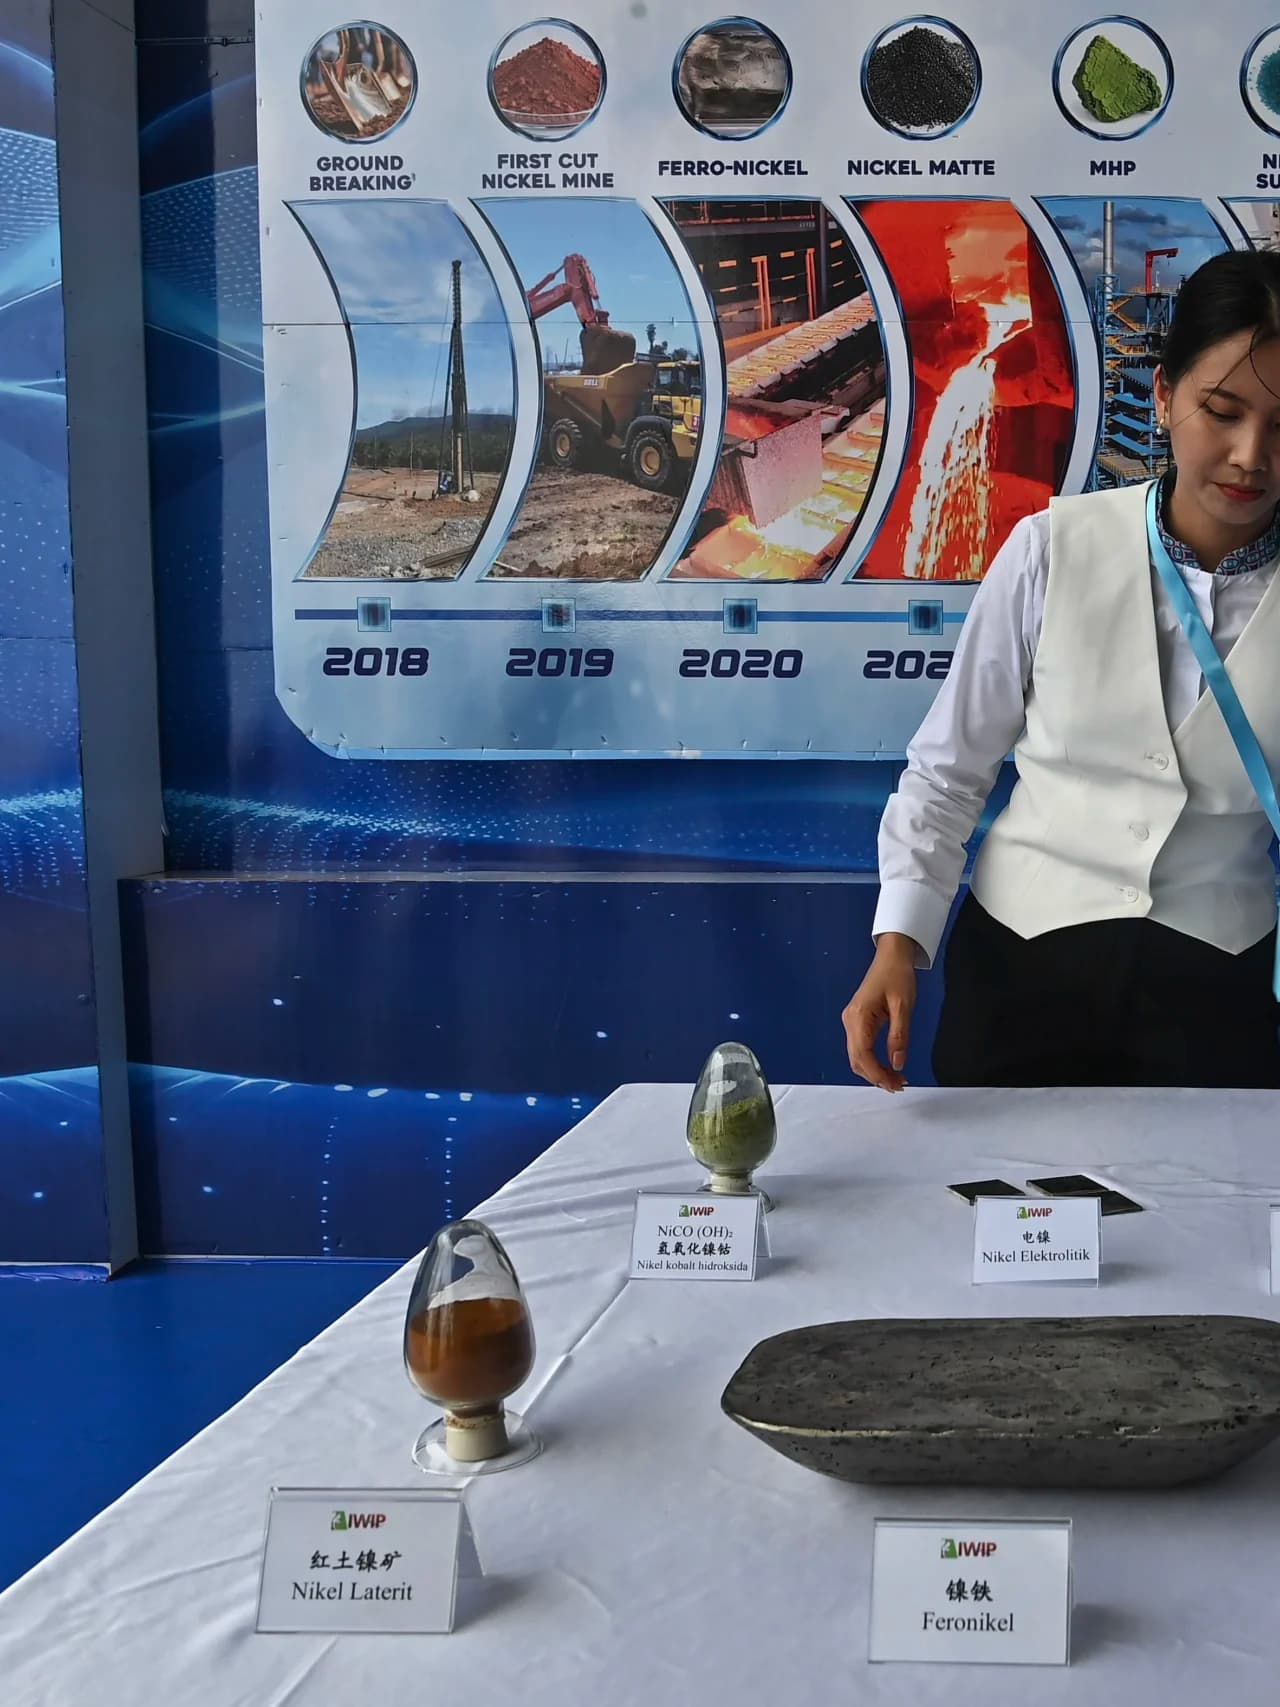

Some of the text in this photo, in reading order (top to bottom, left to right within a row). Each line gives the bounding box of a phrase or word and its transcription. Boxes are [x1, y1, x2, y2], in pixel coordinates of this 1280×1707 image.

[316, 156, 404, 171] GROUND
[496, 153, 599, 169] FIRST CUT
[658, 160, 809, 176] FERRO-NICKEL
[847, 160, 996, 176] NICKEL MATTE
[1089, 160, 1137, 176] MHP
[309, 175, 413, 192] BREAKING
[481, 173, 615, 190] NICKEL MINE
[322, 647, 429, 677] 2018
[505, 648, 614, 678] 2019
[678, 649, 804, 679] 2020
[690, 1206, 714, 1216] IWIP
[1028, 1207, 1053, 1218] IWIP
[1022, 1229, 1051, 1245] 电镍
[983, 1249, 1090, 1263] Nikel Elektrolitik
[637, 1260, 748, 1272] Nikel kobalt hidroksida
[348, 1514, 386, 1529] IWIP
[957, 1541, 997, 1557] IWIP
[309, 1548, 402, 1573] 红土镍矿
[292, 1582, 413, 1600] Nikel Laterit
[945, 1577, 993, 1602] 镍铁
[922, 1611, 1014, 1632] Feronikel
